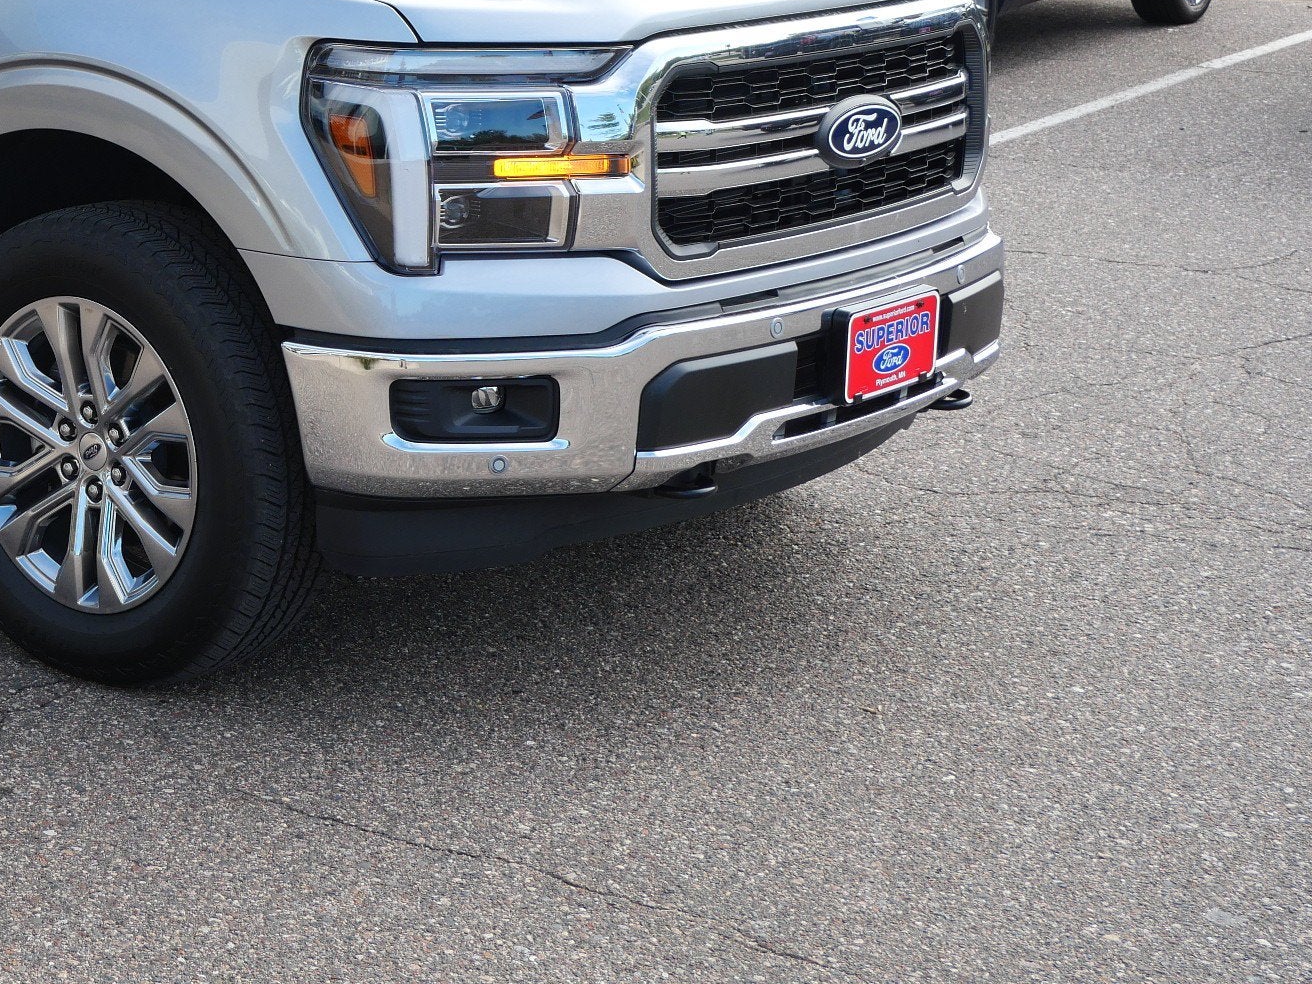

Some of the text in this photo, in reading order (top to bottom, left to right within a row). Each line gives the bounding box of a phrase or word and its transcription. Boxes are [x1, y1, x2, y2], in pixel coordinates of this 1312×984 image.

[843, 112, 888, 151] Ford
[855, 311, 931, 354] SUPERIOR
[880, 348, 904, 369] Ford
[875, 370, 906, 387] Plymouth, MN
